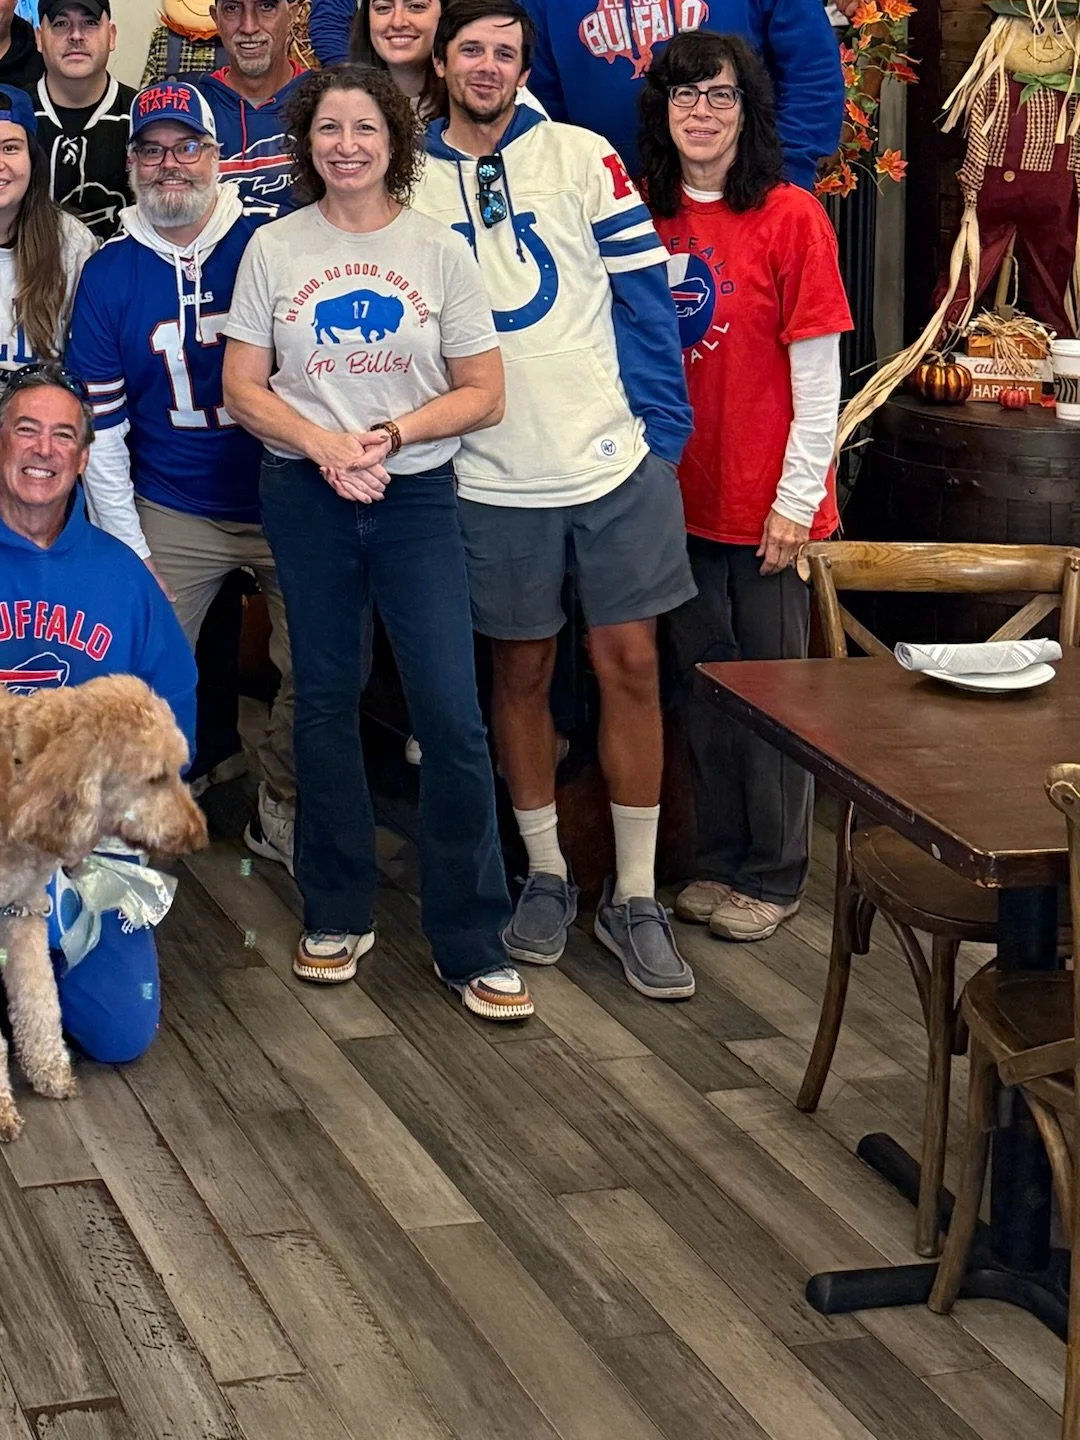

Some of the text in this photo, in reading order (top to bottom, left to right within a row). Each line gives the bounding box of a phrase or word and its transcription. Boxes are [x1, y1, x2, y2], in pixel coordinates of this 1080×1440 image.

[138, 85, 191, 103] BILLS
[138, 95, 191, 118] MAFIA
[670, 236, 735, 295] FFALO
[285, 307, 300, 323] BE
[293, 278, 324, 307] GOOD.
[324, 266, 341, 281] DO
[345, 263, 381, 278] GOOD.
[385, 270, 409, 292] GOD
[352, 300, 370, 319] 17
[306, 350, 413, 379] Go Bills!
[973, 383, 1035, 401] HART
